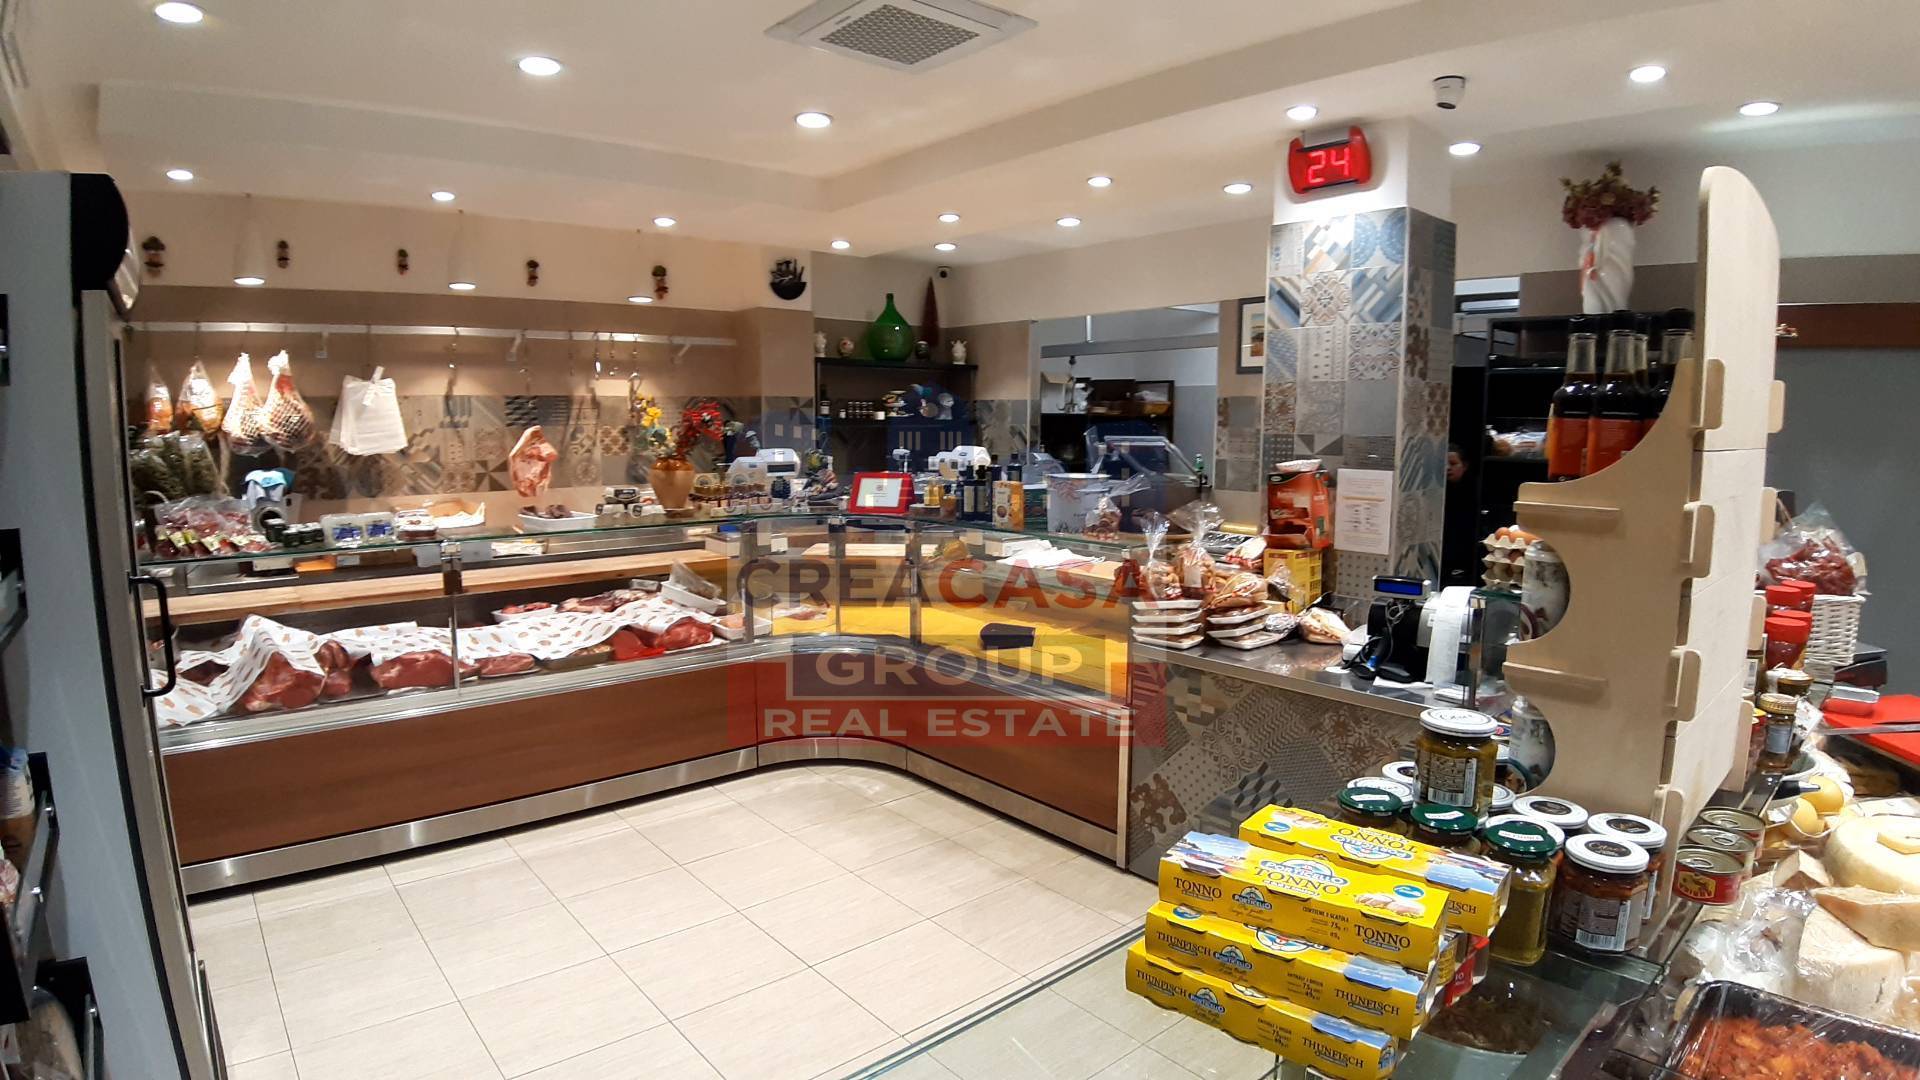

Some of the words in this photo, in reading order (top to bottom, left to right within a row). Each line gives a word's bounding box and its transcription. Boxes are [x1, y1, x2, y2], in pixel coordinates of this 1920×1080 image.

[1308, 148, 1350, 183] 24
[1338, 828, 1418, 854] TONNO
[1254, 866, 1341, 895] TONNO
[1263, 860, 1345, 885] PORTICELLO
[1173, 877, 1222, 899] TONNO
[1156, 931, 1212, 957] THUNFISCH
[1354, 924, 1411, 949] TONNO
[1136, 969, 1188, 998] THUNFISCH
[1335, 988, 1400, 1016] THUNFISCH
[1302, 1036, 1365, 1069] THUNFISCH
